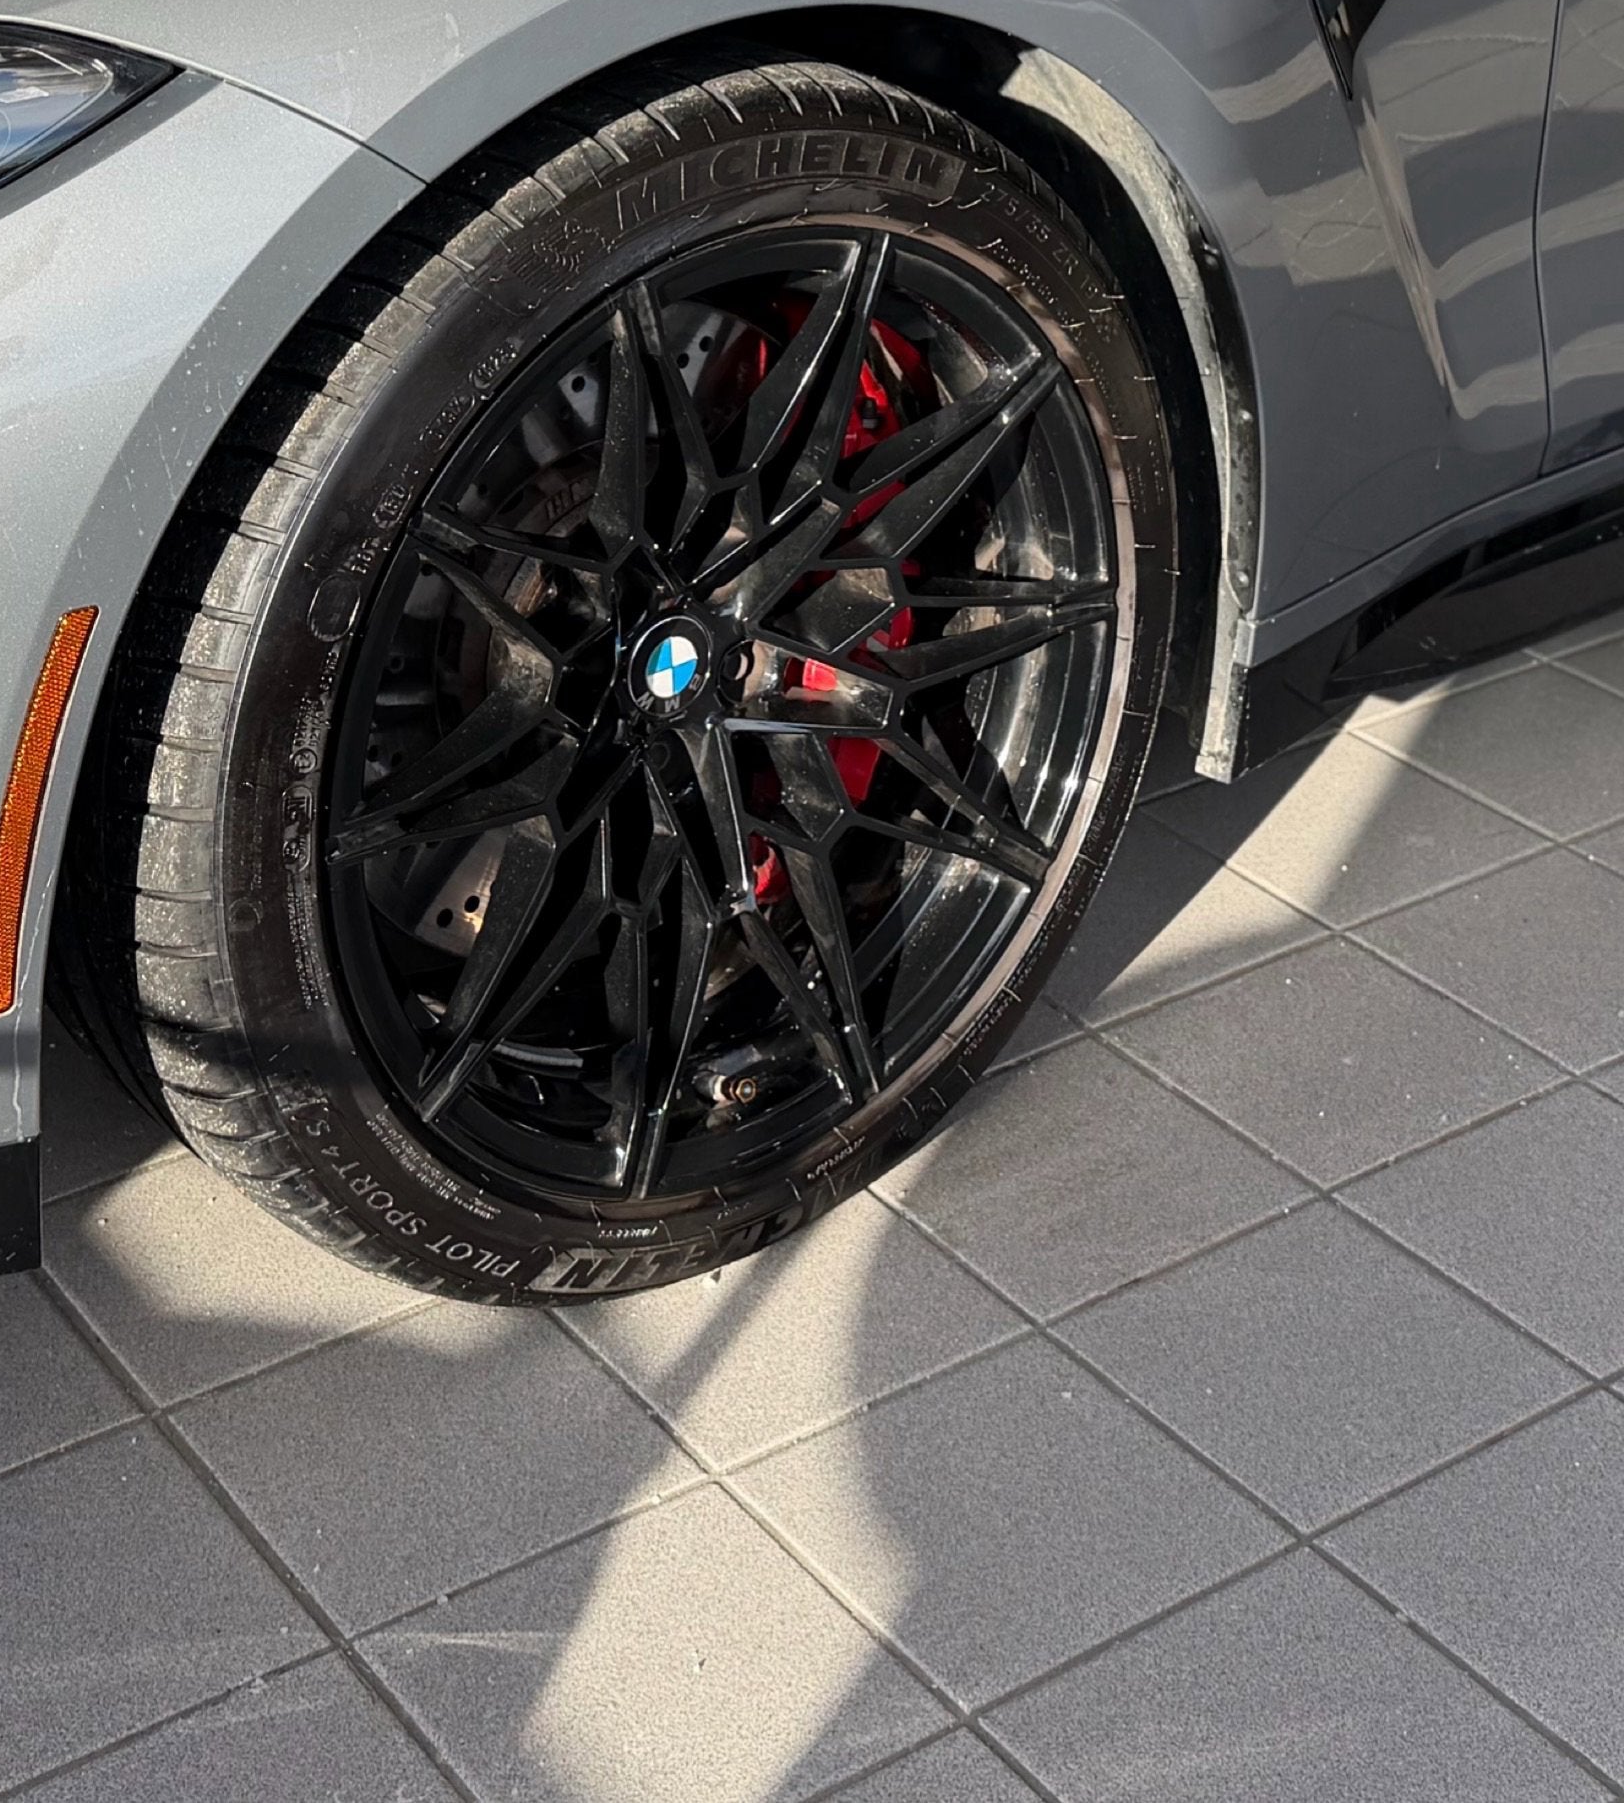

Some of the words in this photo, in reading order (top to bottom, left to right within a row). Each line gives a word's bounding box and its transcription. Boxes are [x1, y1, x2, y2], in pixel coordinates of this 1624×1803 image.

[616, 133, 947, 233] MICHELIN
[330, 1160, 428, 1236] SPORT
[426, 1233, 521, 1279] PILOT
